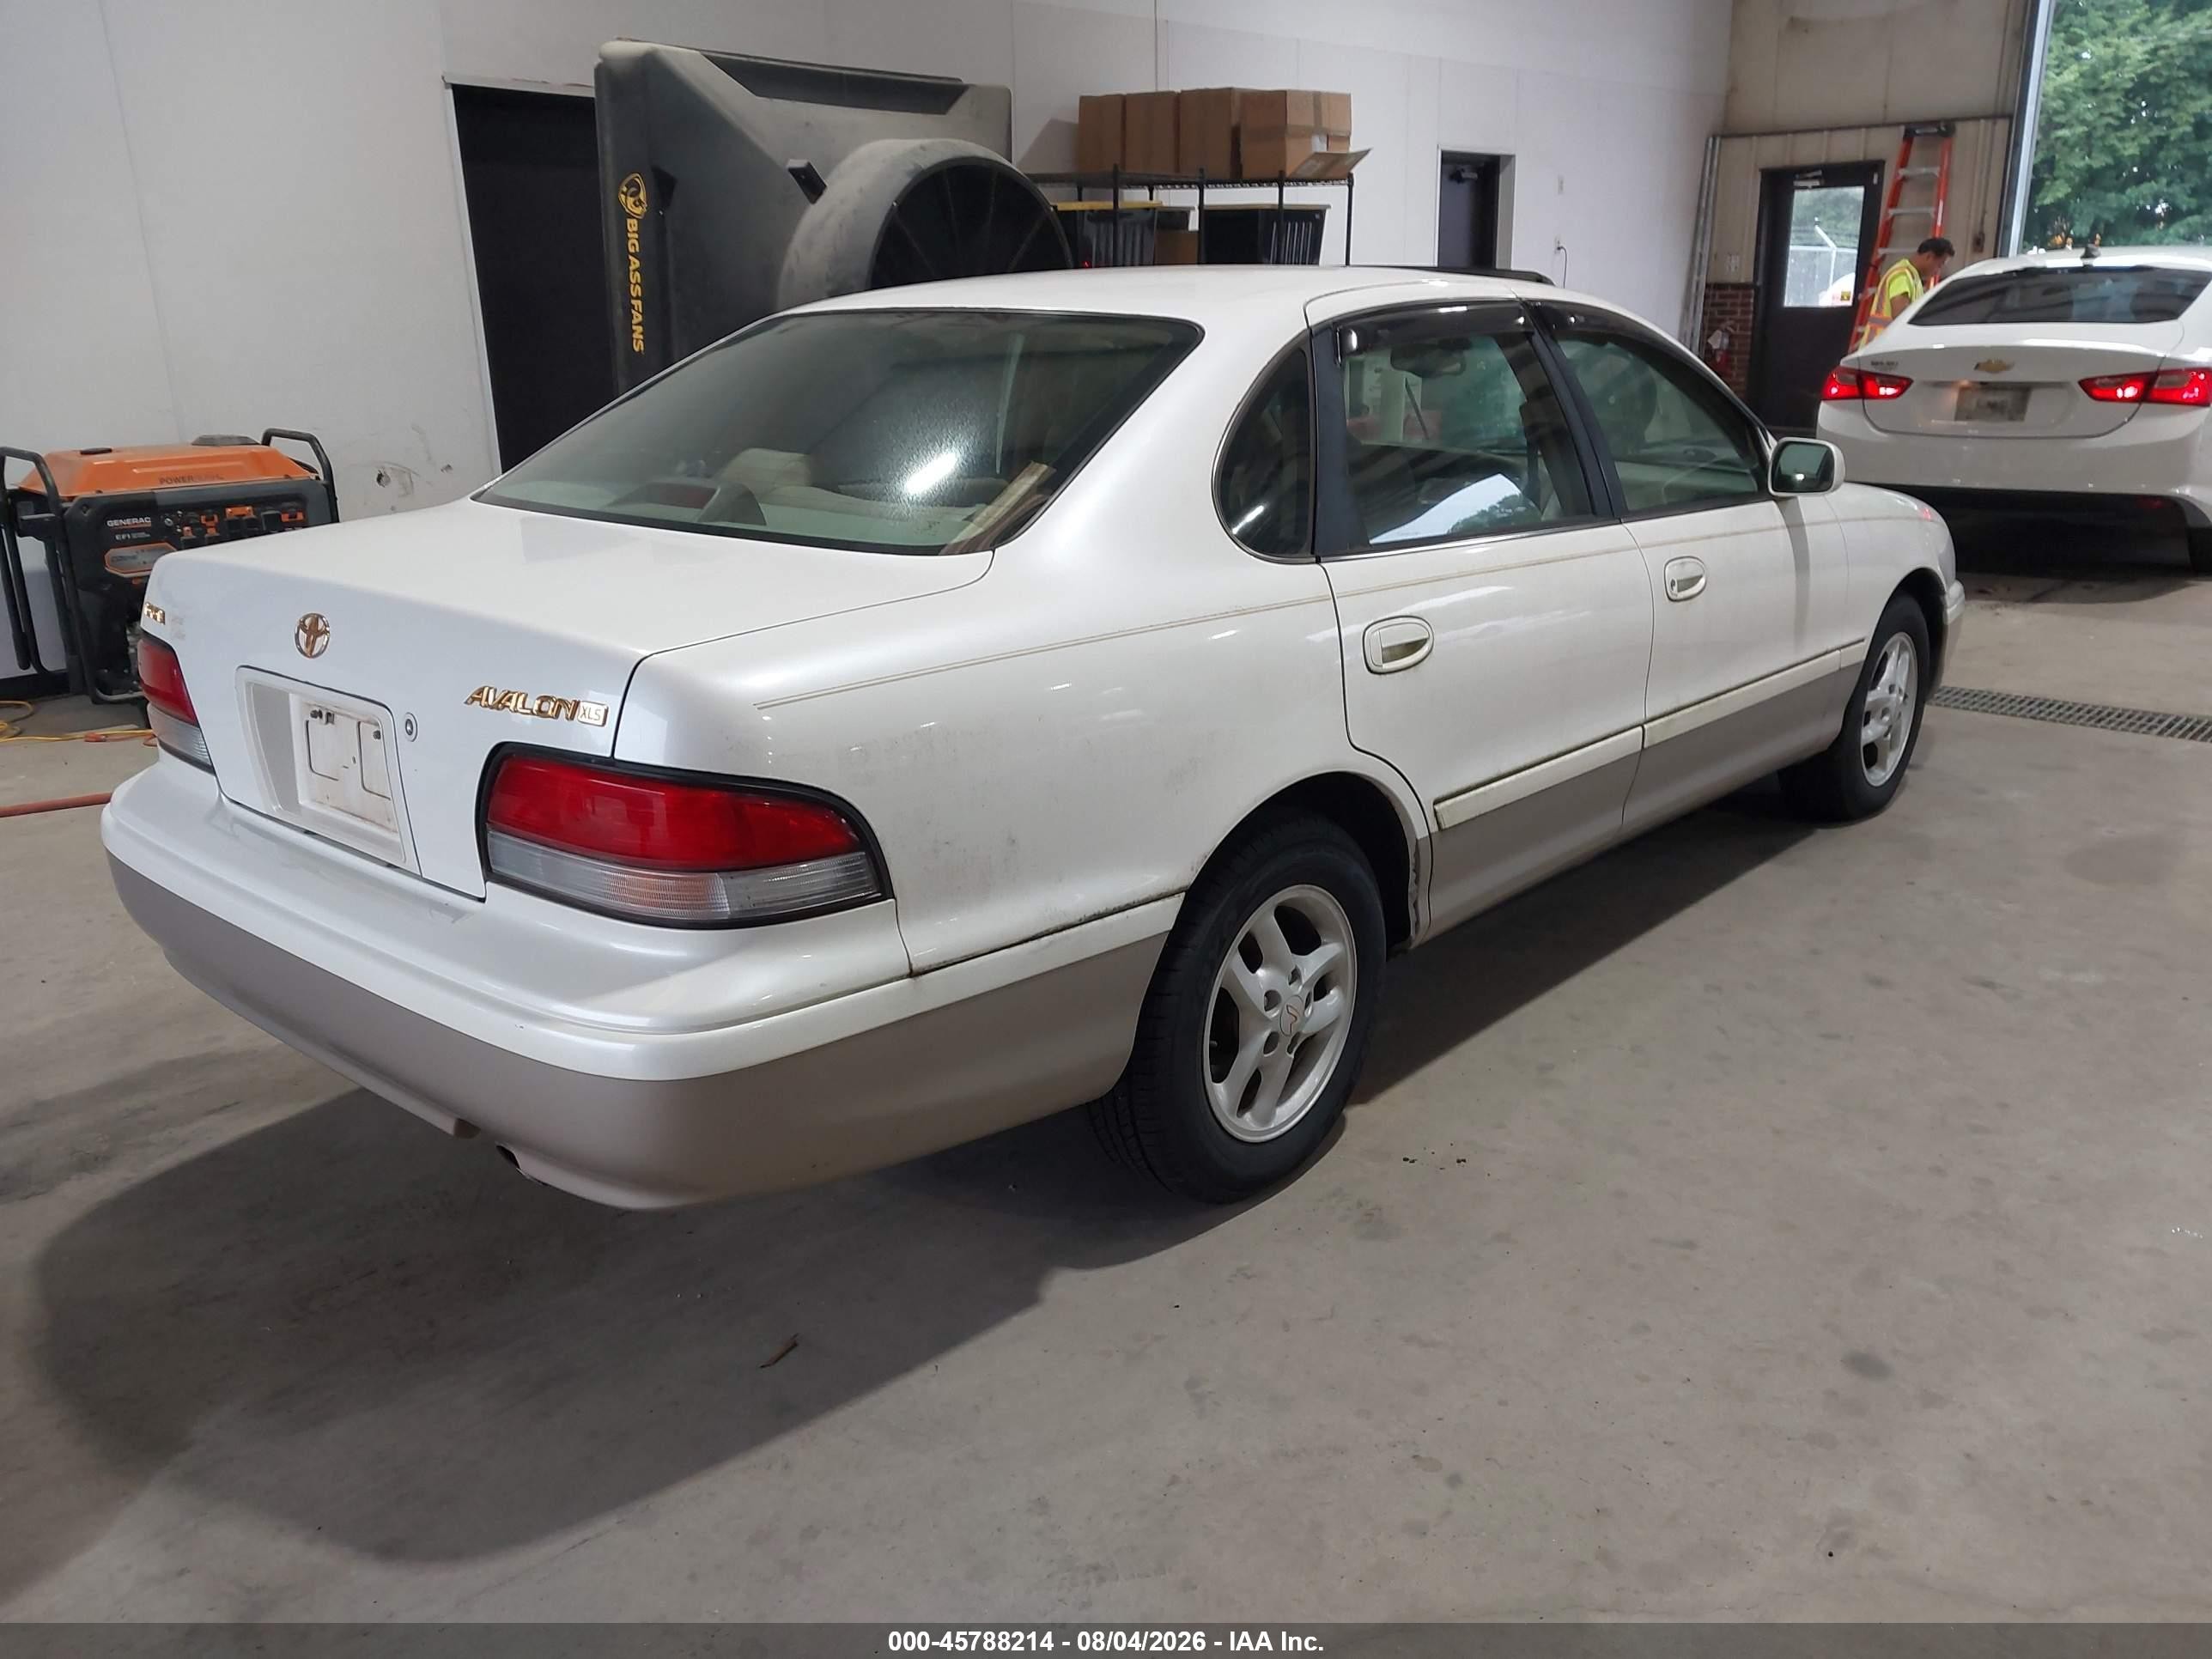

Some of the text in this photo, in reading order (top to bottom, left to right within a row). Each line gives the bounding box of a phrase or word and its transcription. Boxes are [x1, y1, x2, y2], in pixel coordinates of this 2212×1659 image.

[626, 218, 645, 353] BIG ASS FANS
[106, 517, 151, 526] GENERAC
[464, 686, 604, 722] AVALON XLS
